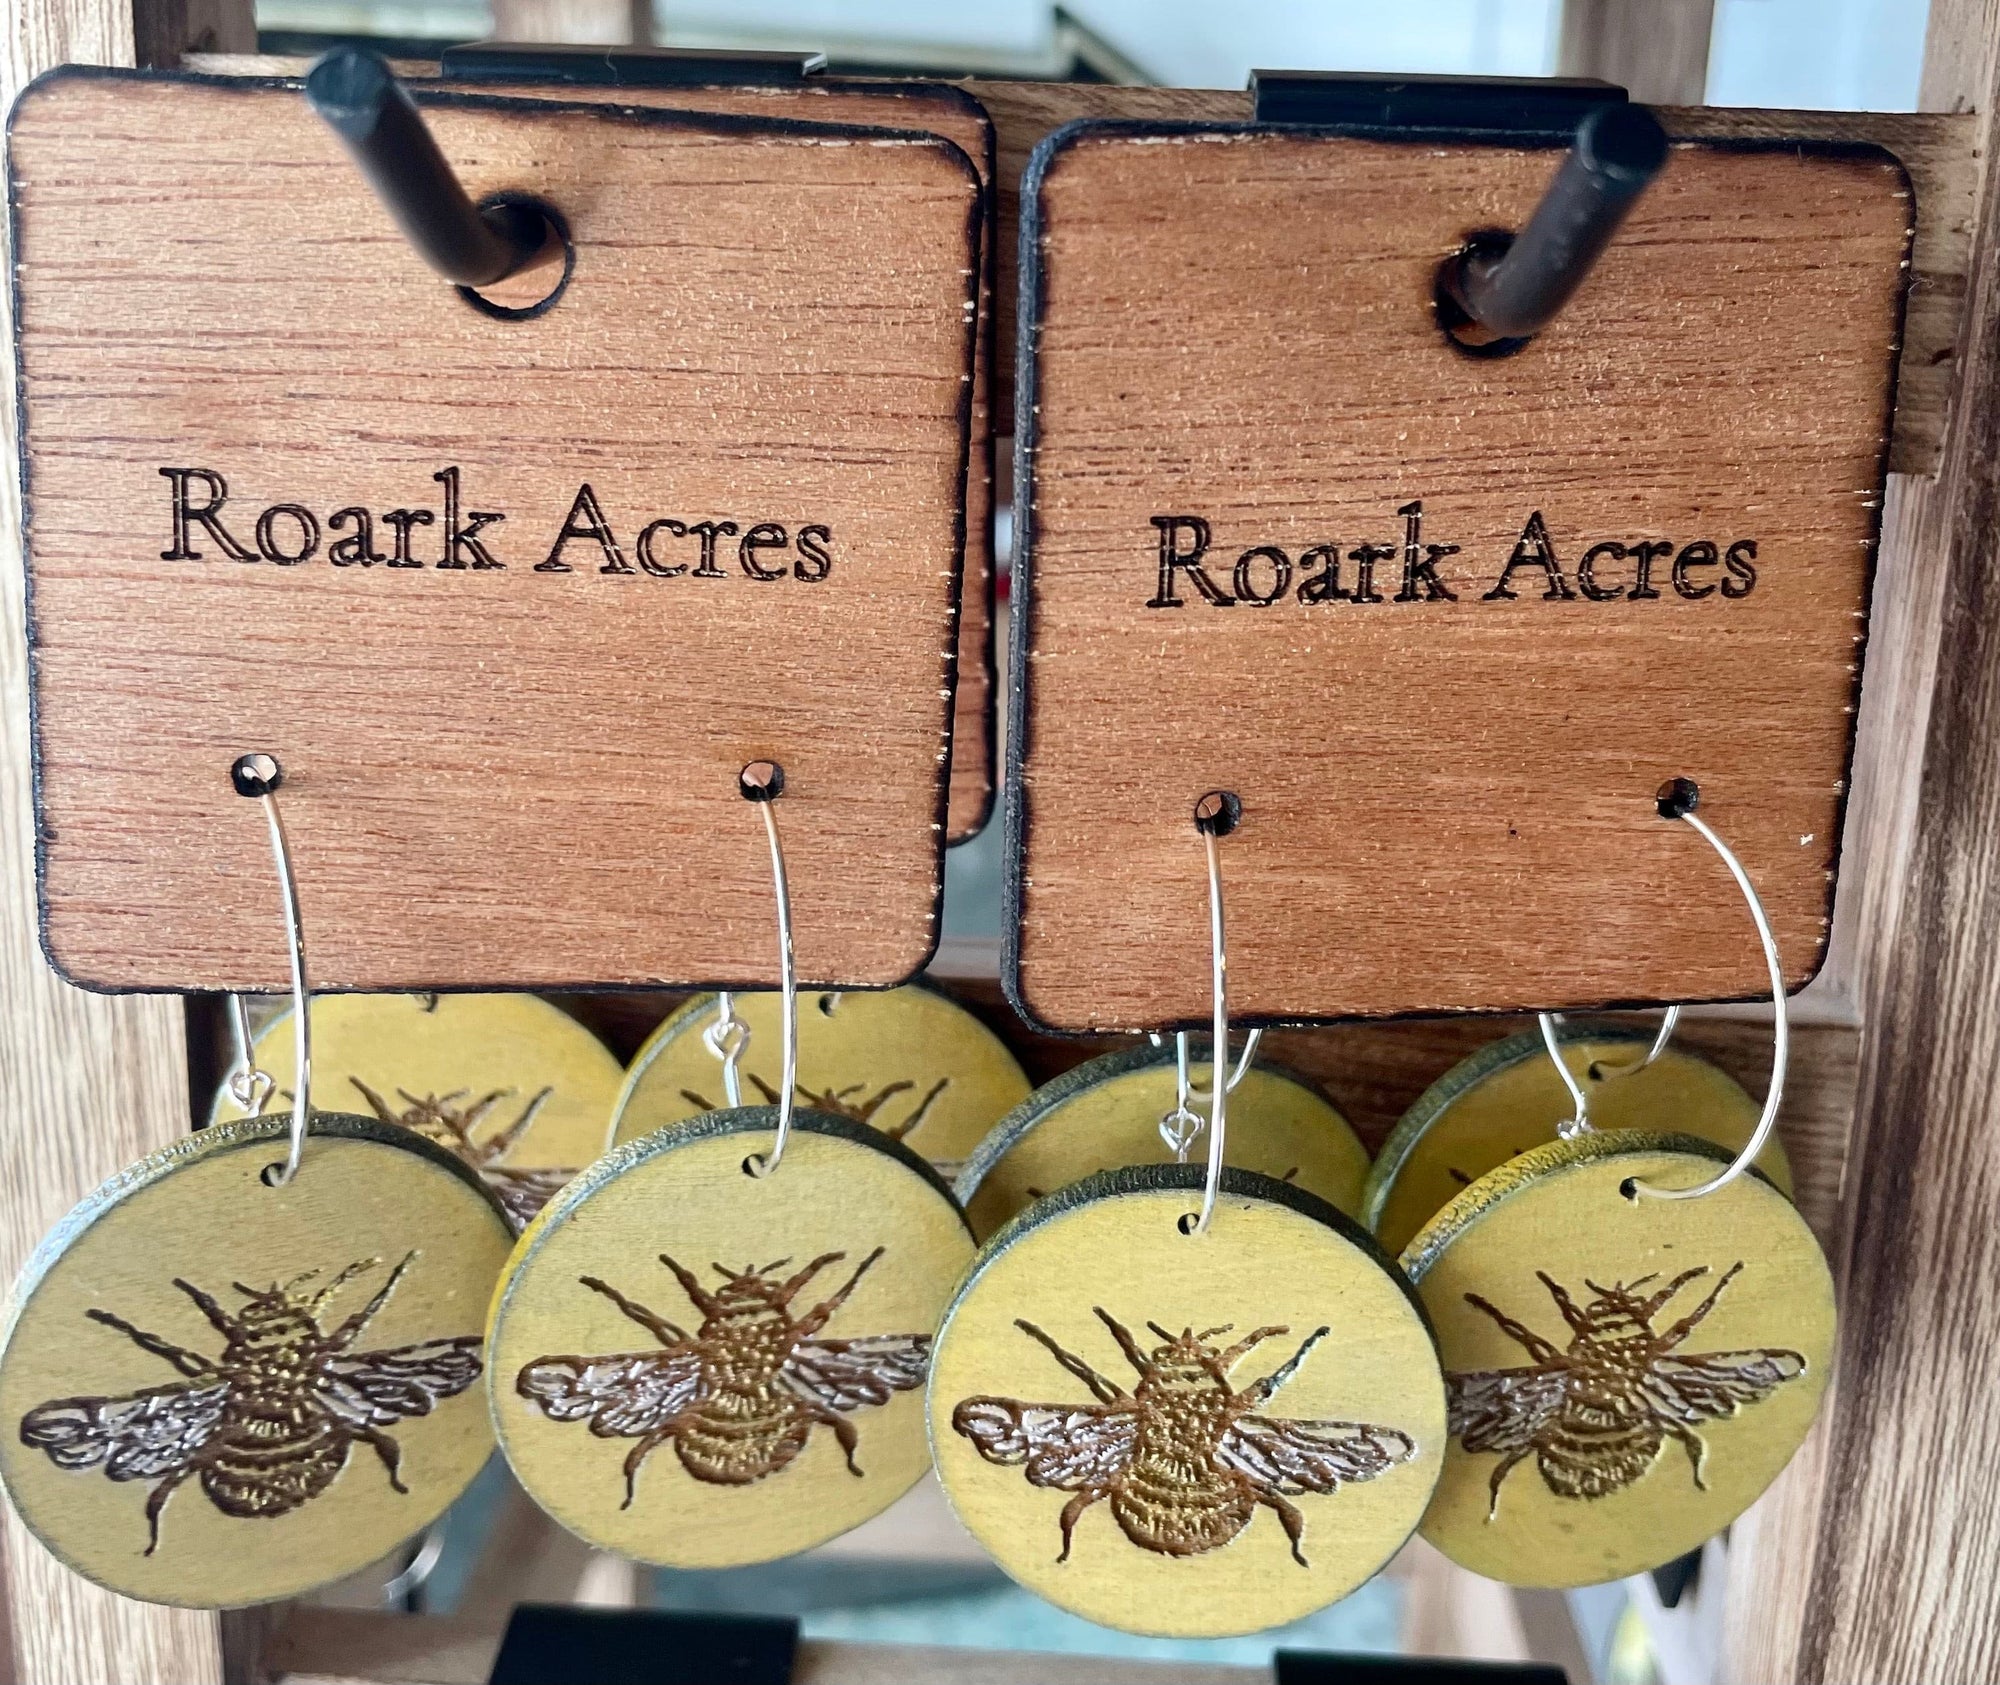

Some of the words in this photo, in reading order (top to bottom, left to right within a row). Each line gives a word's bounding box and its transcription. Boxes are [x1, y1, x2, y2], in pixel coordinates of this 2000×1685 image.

[158, 465, 508, 570] Roark
[534, 483, 832, 583] Acres
[1145, 500, 1461, 609] Roark
[1482, 510, 1759, 602] Acres
